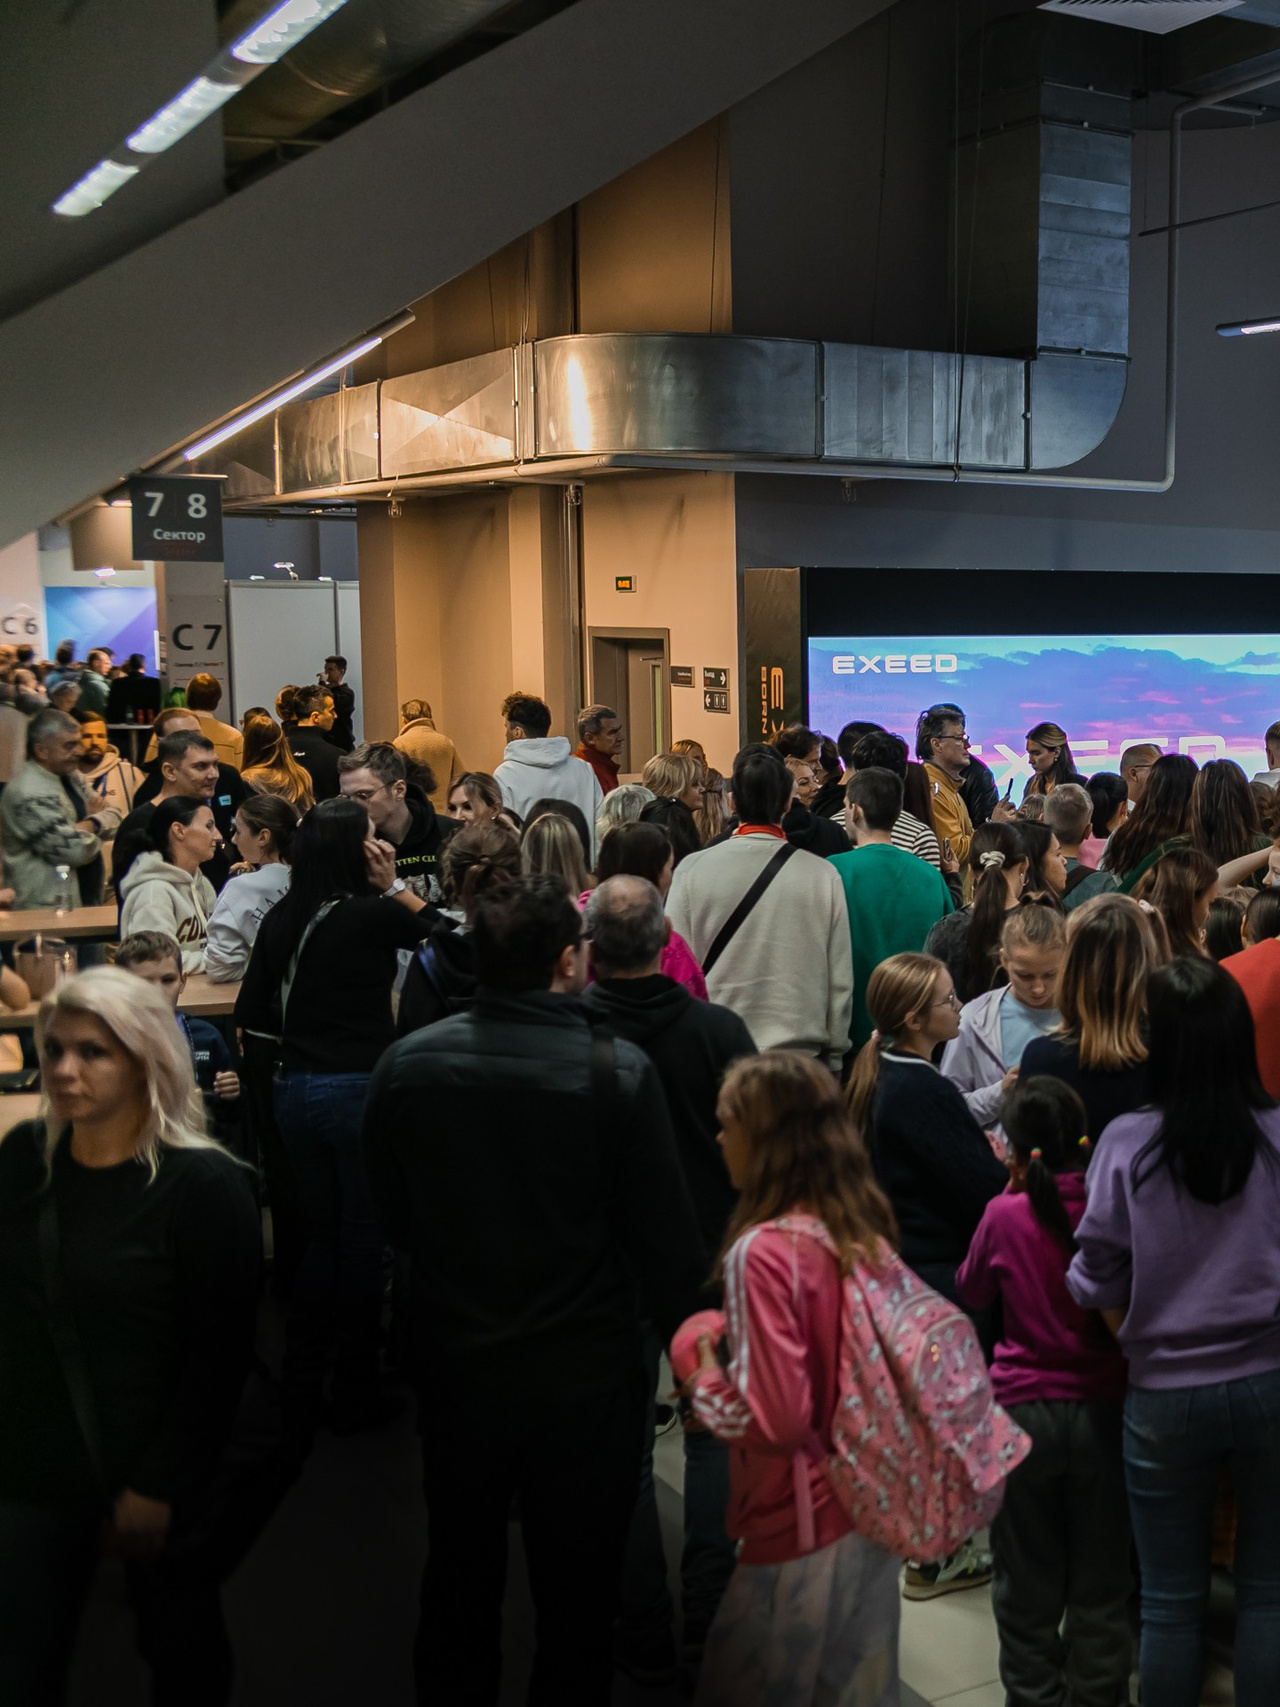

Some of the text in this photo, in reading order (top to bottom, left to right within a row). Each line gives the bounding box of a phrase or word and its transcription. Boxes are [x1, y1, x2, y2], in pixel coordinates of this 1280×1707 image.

[144, 491, 207, 518] 7 8
[153, 528, 206, 543] Сектор
[832, 654, 958, 675] EXEED
